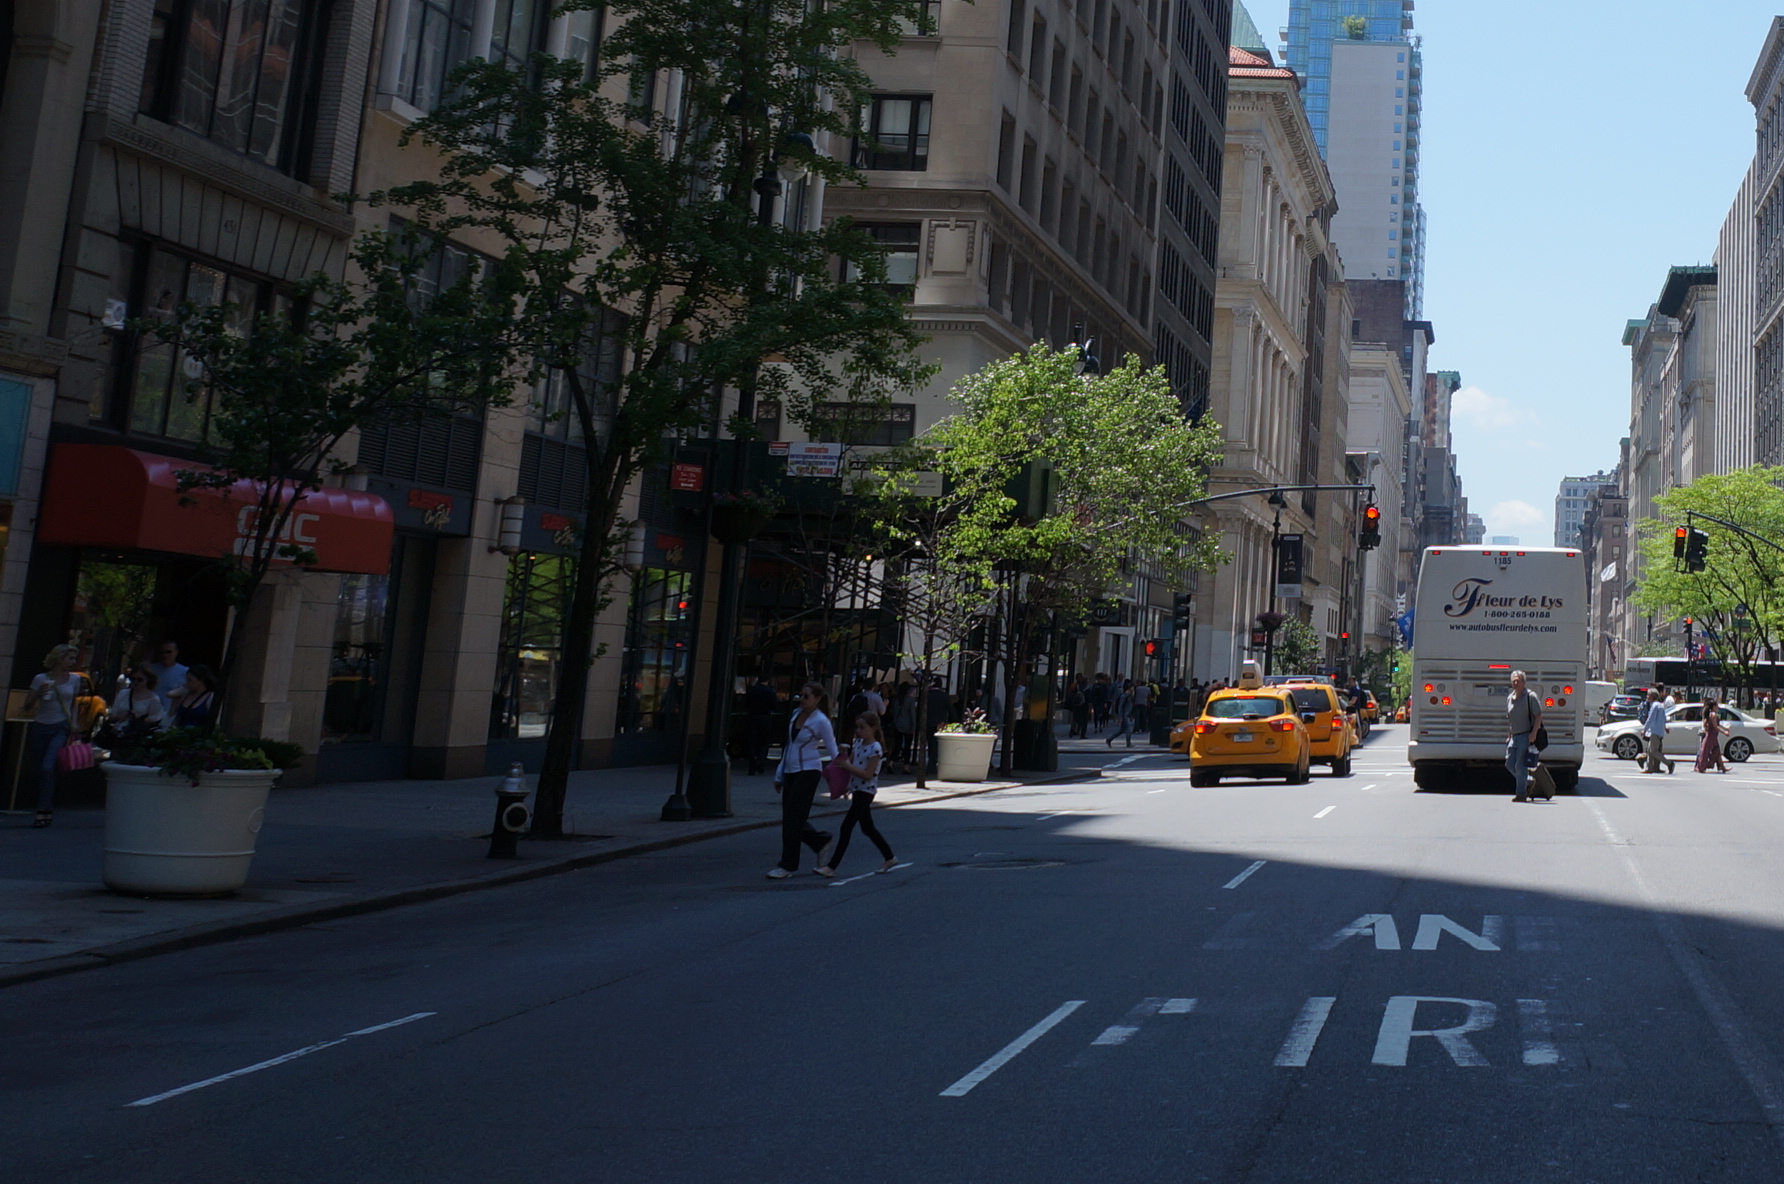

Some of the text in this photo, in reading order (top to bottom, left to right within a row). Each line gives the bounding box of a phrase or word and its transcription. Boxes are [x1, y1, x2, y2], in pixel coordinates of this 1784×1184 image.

[1494, 557, 1512, 565] 1185
[1518, 594, 1538, 608] de
[1540, 595, 1564, 611] Lys
[1484, 611, 1551, 619] 1-800-265-0188
[1449, 623, 1558, 633] www.autobusfleurdelys.com
